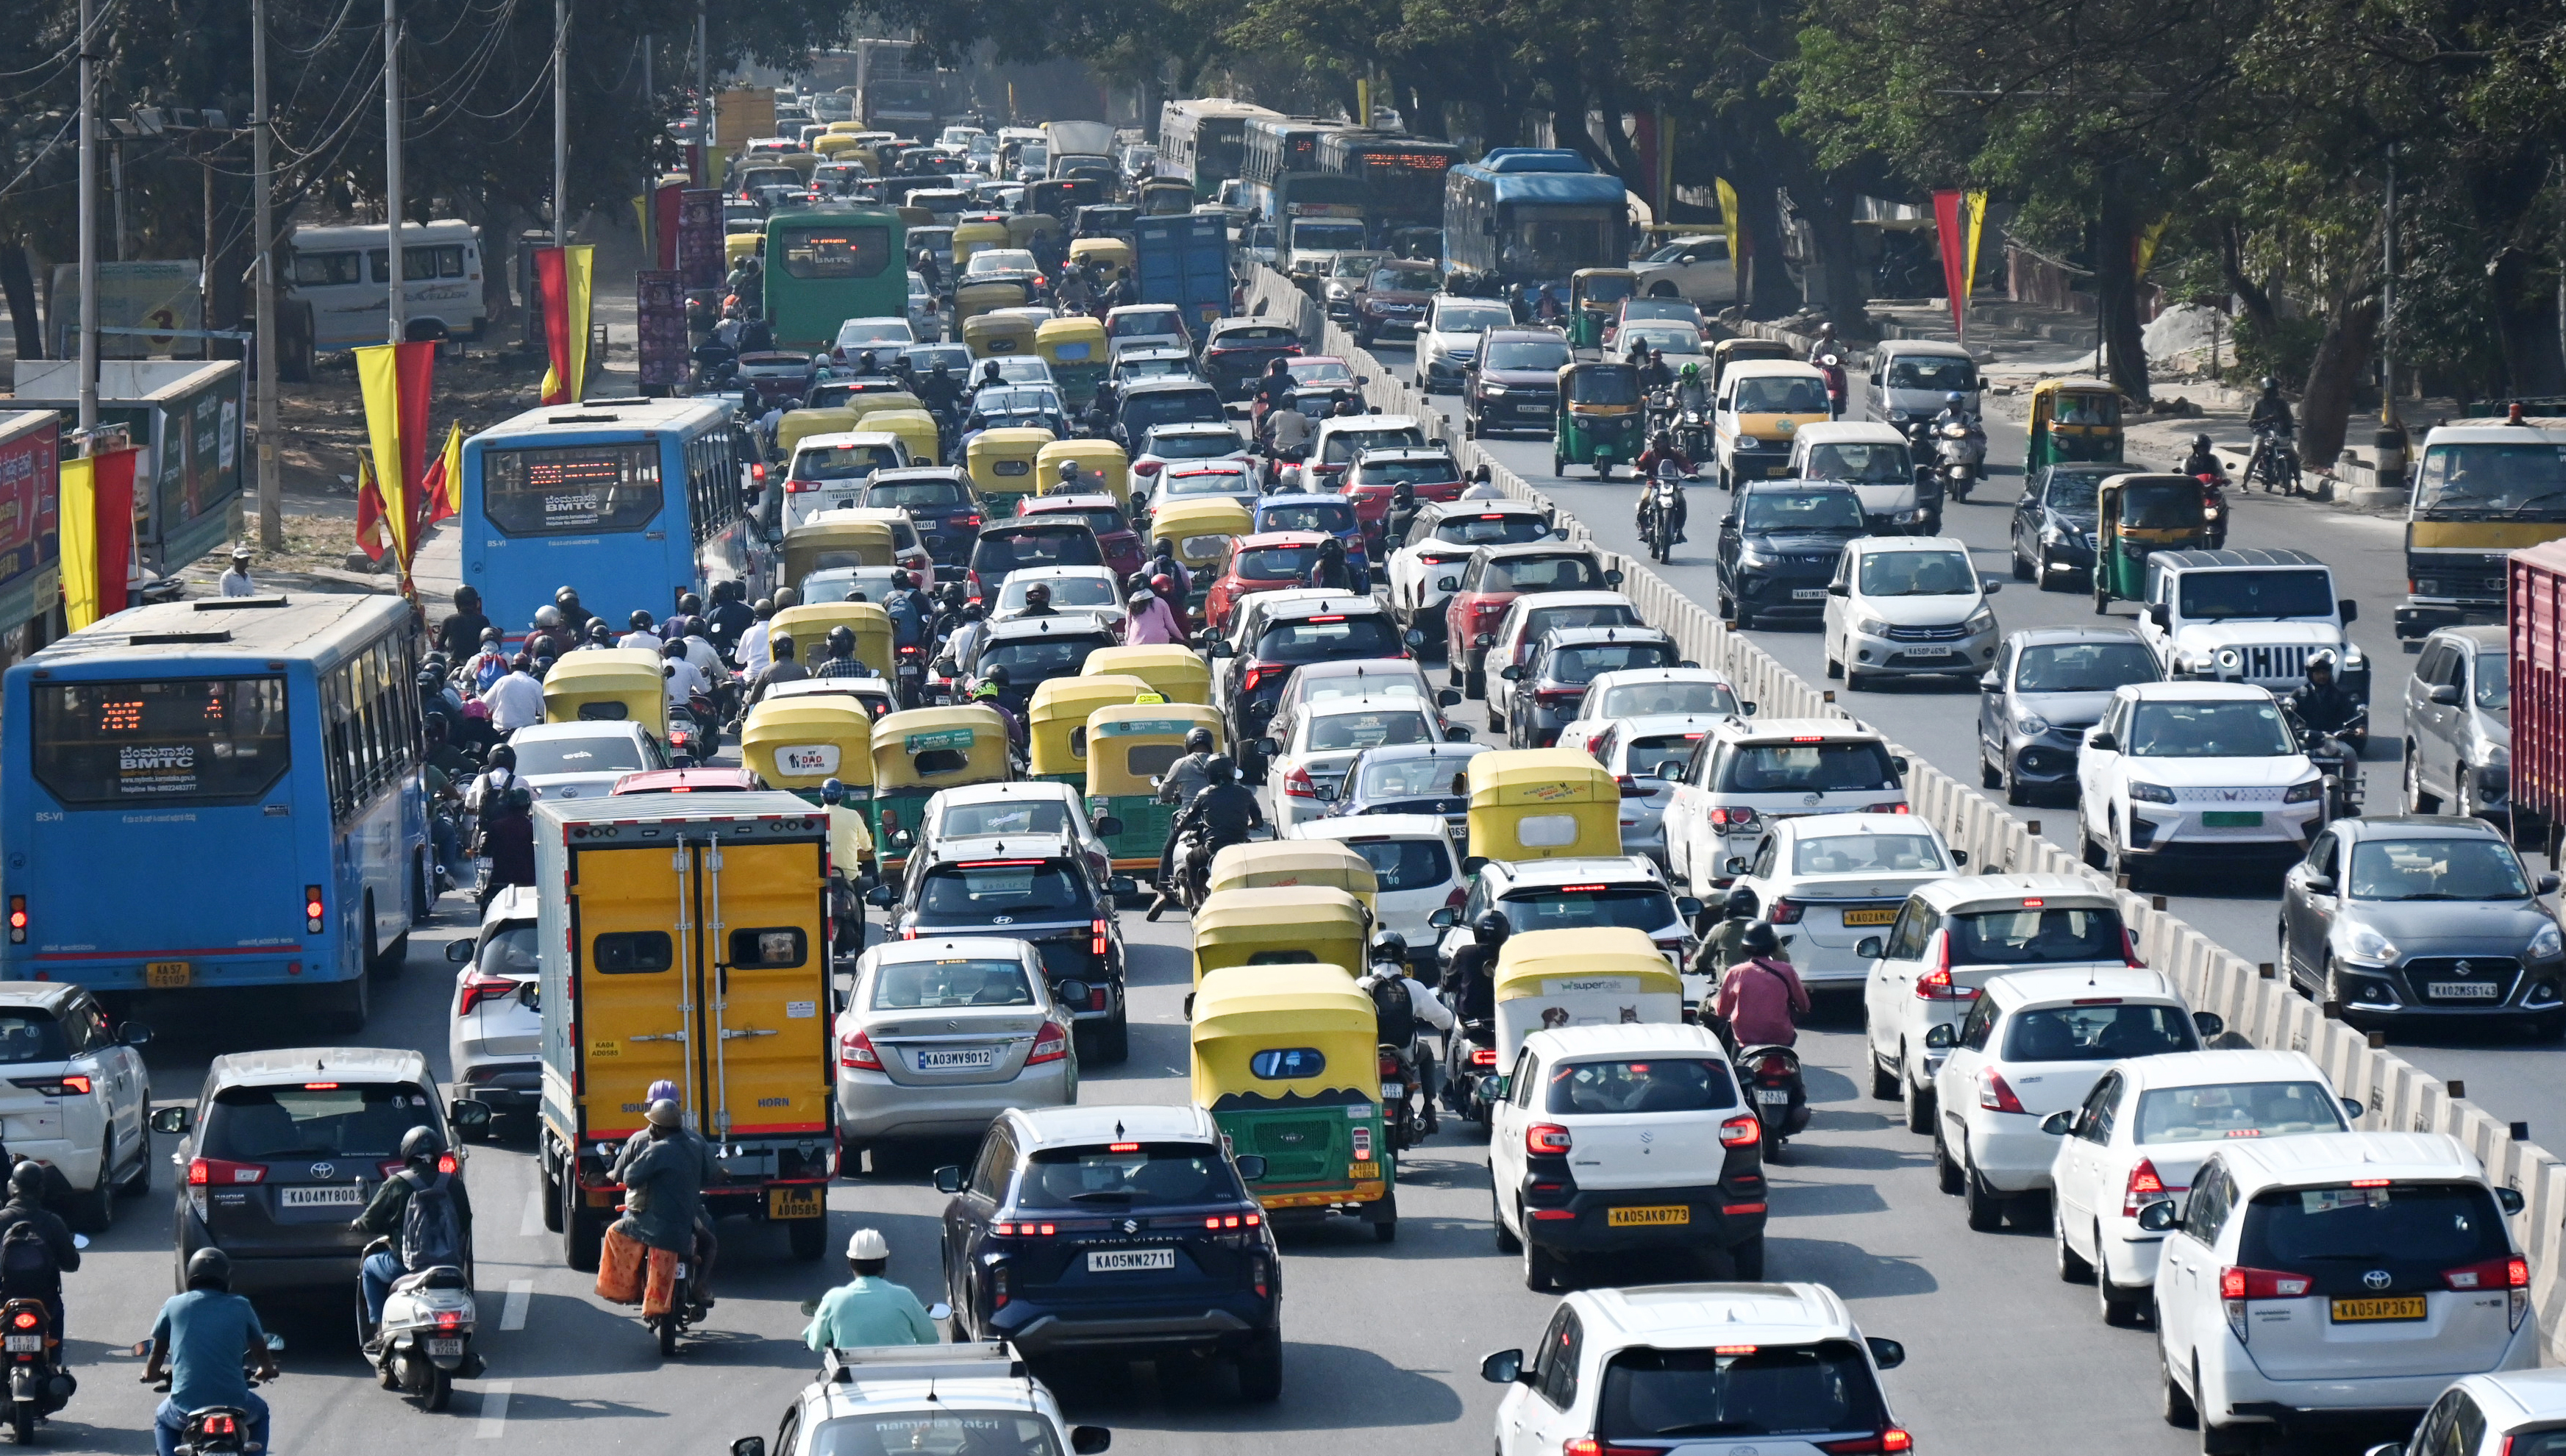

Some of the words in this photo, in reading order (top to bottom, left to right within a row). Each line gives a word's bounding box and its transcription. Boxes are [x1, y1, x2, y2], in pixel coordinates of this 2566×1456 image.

[545, 502, 596, 512] BMTC
[120, 757, 193, 769] BMTC
[36, 813, 63, 821] BS-VI
[157, 965, 168, 974] KA
[171, 964, 182, 974] 57
[1573, 980, 1622, 991] supertails
[926, 1052, 989, 1066] KA03MV9012
[758, 1098, 789, 1108] HORN
[291, 1189, 358, 1203] KA04MY800
[777, 1204, 818, 1216] AD0585
[1616, 1209, 1687, 1223] KA05AK8773
[1096, 1252, 1172, 1268] KA05NN2711
[2341, 1299, 2423, 1317] KA05AP3671
[876, 1419, 949, 1432] namma
[956, 1419, 999, 1430] yatri
